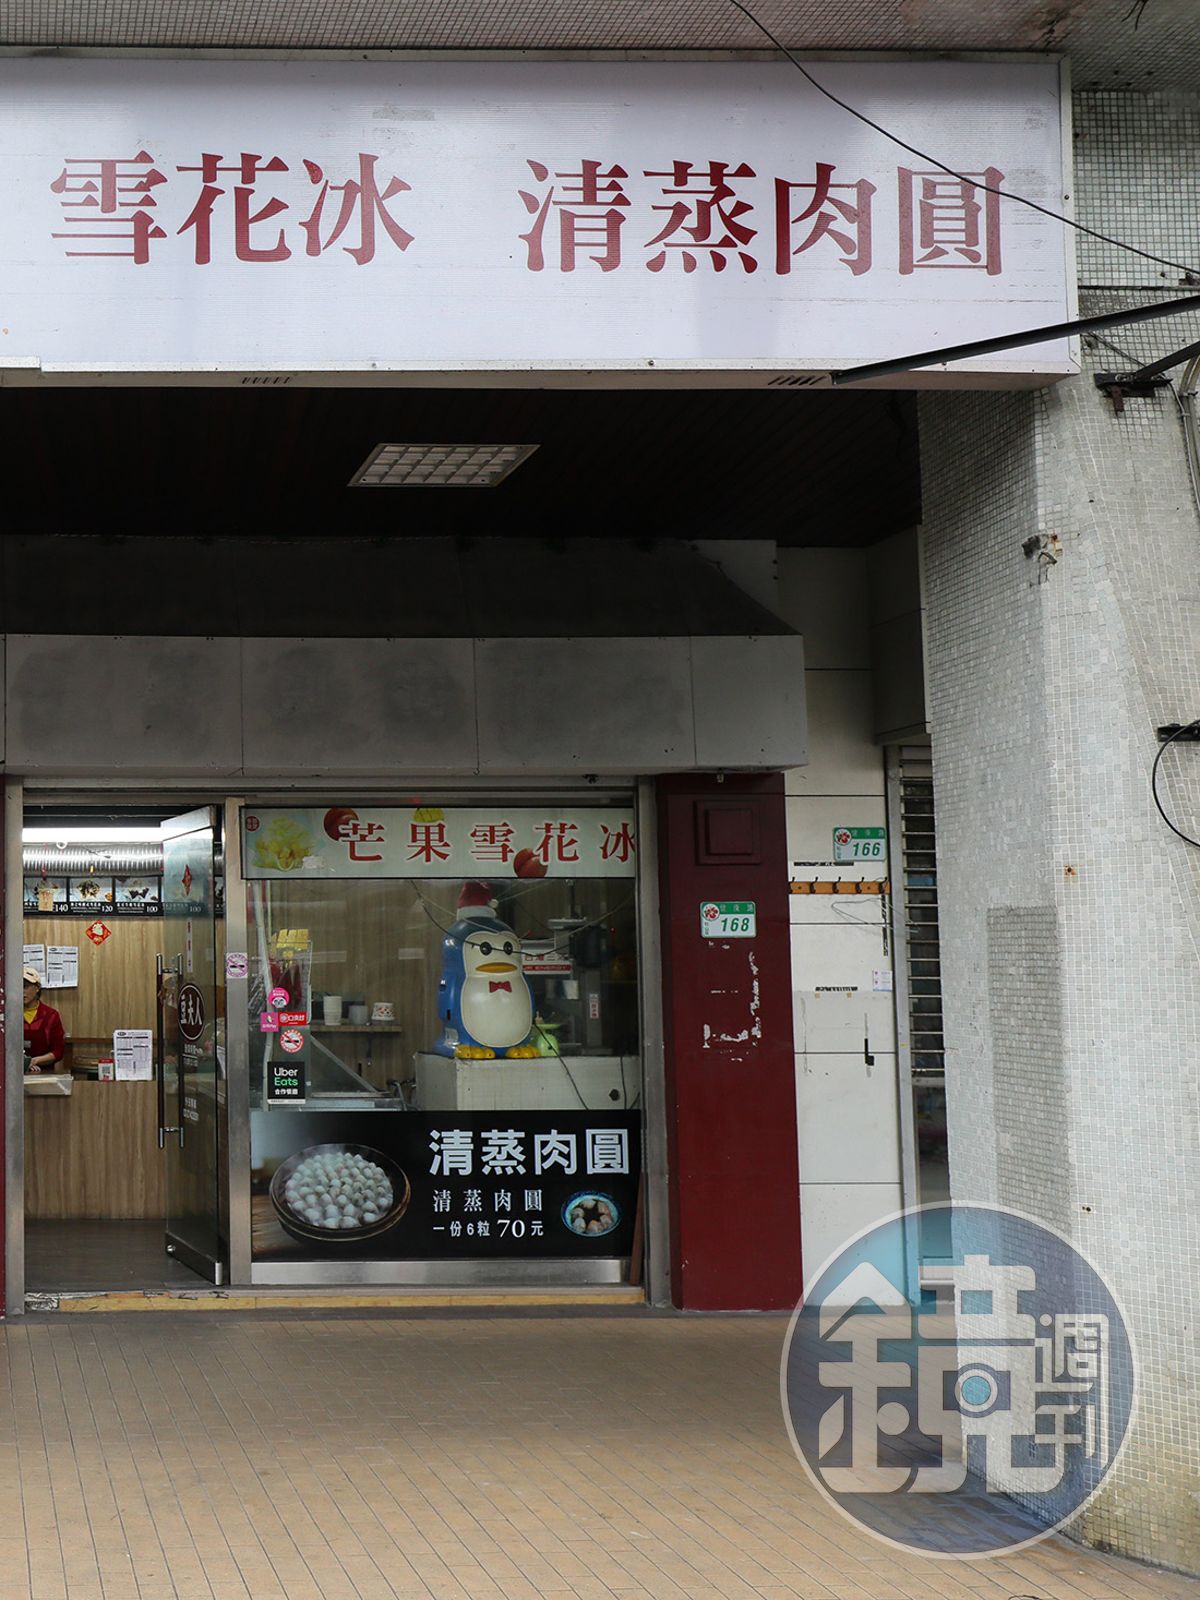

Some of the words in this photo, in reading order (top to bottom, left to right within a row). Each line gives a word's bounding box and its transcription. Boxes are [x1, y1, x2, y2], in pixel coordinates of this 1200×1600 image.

[50, 150, 416, 266] 雪花冰
[518, 159, 1006, 277] 清蒸肉圓
[341, 822, 635, 863] 芒果雪花冰
[853, 842, 881, 857] 166
[55, 904, 68, 912] 140
[721, 917, 750, 932] 168
[180, 993, 203, 1026] 豆夫人
[274, 1067, 298, 1077] Uber
[274, 1077, 298, 1086] Eats
[428, 1128, 630, 1176] 清蒸肉圓
[433, 1189, 543, 1213] 清蒸肉圓
